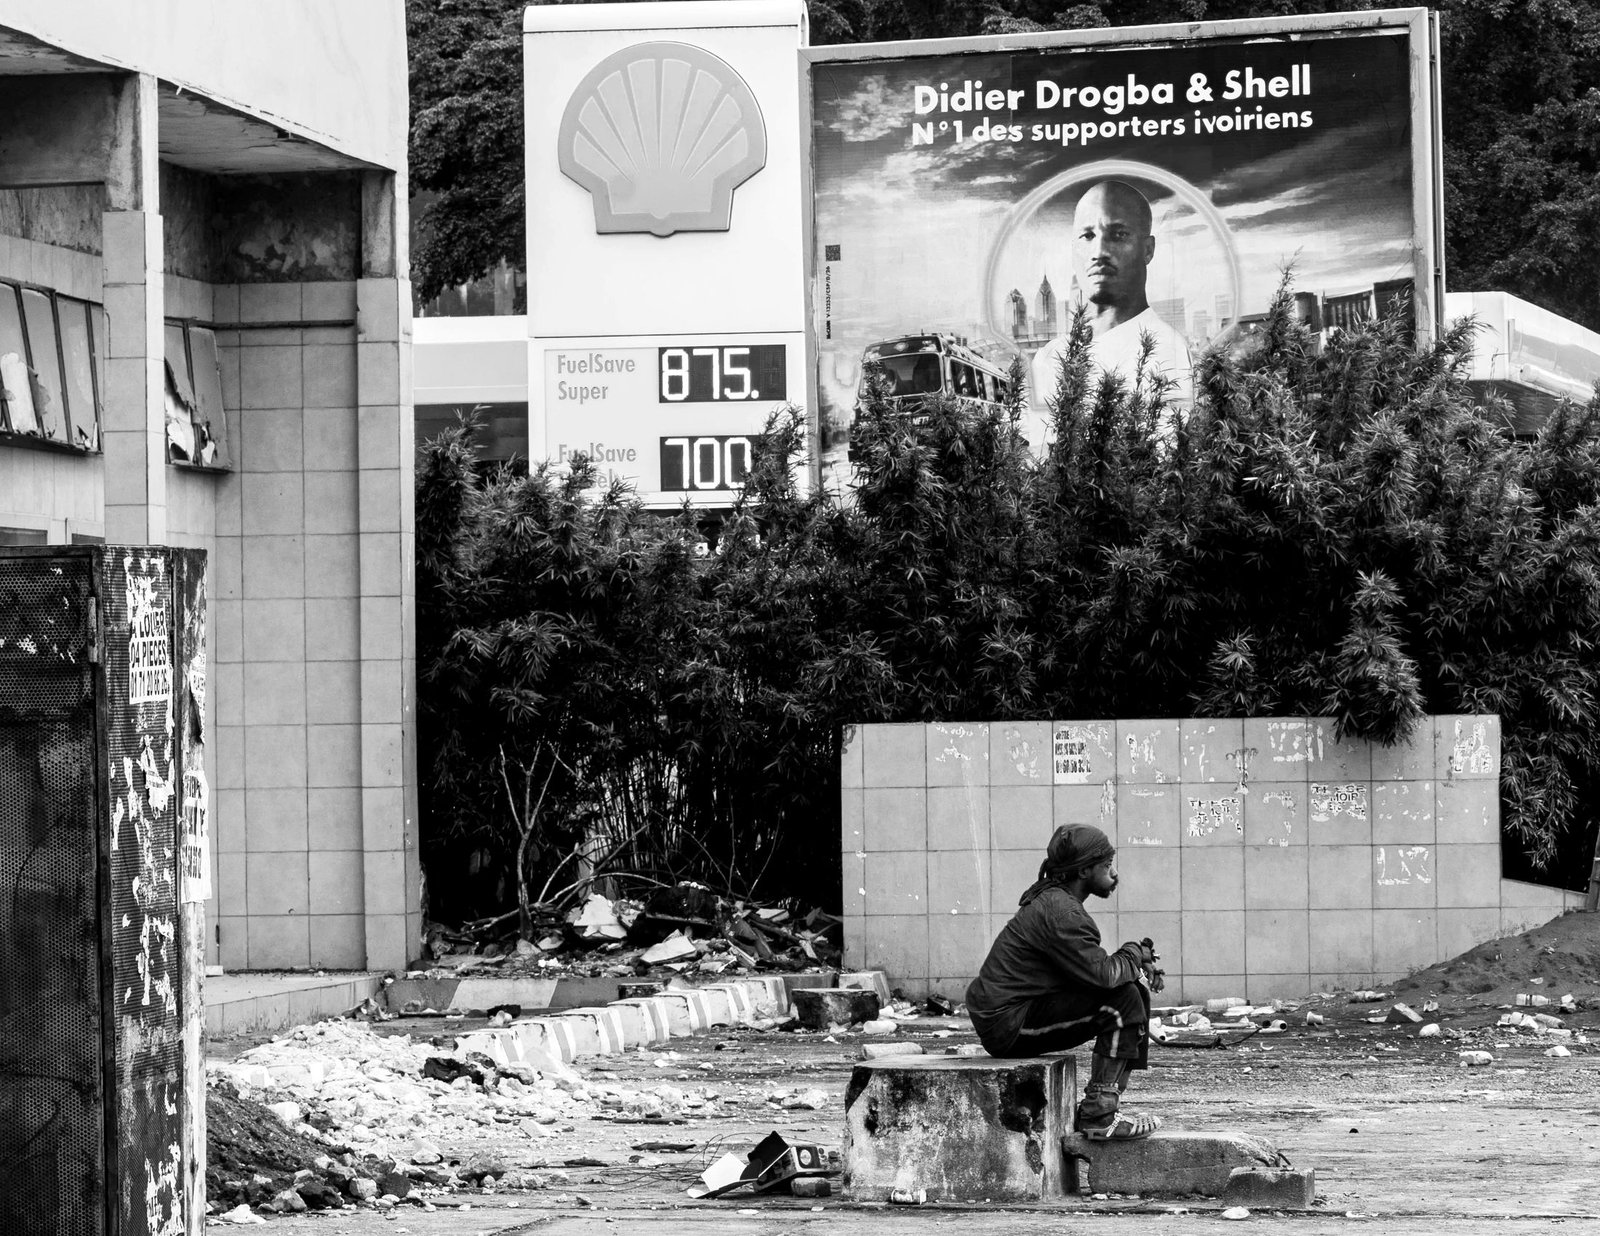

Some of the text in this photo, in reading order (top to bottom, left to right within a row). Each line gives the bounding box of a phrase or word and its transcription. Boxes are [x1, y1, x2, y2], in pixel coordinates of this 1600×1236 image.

[914, 63, 1311, 116] Didier Drogba & Shell
[972, 117, 1024, 143] des
[1031, 113, 1186, 147] supporters
[1194, 105, 1314, 135] ivoiriens
[557, 353, 636, 375] FuelSave
[557, 381, 608, 405] Super
[664, 437, 751, 490] 700
[139, 610, 166, 639] LOUER
[142, 640, 167, 668] PIECES
